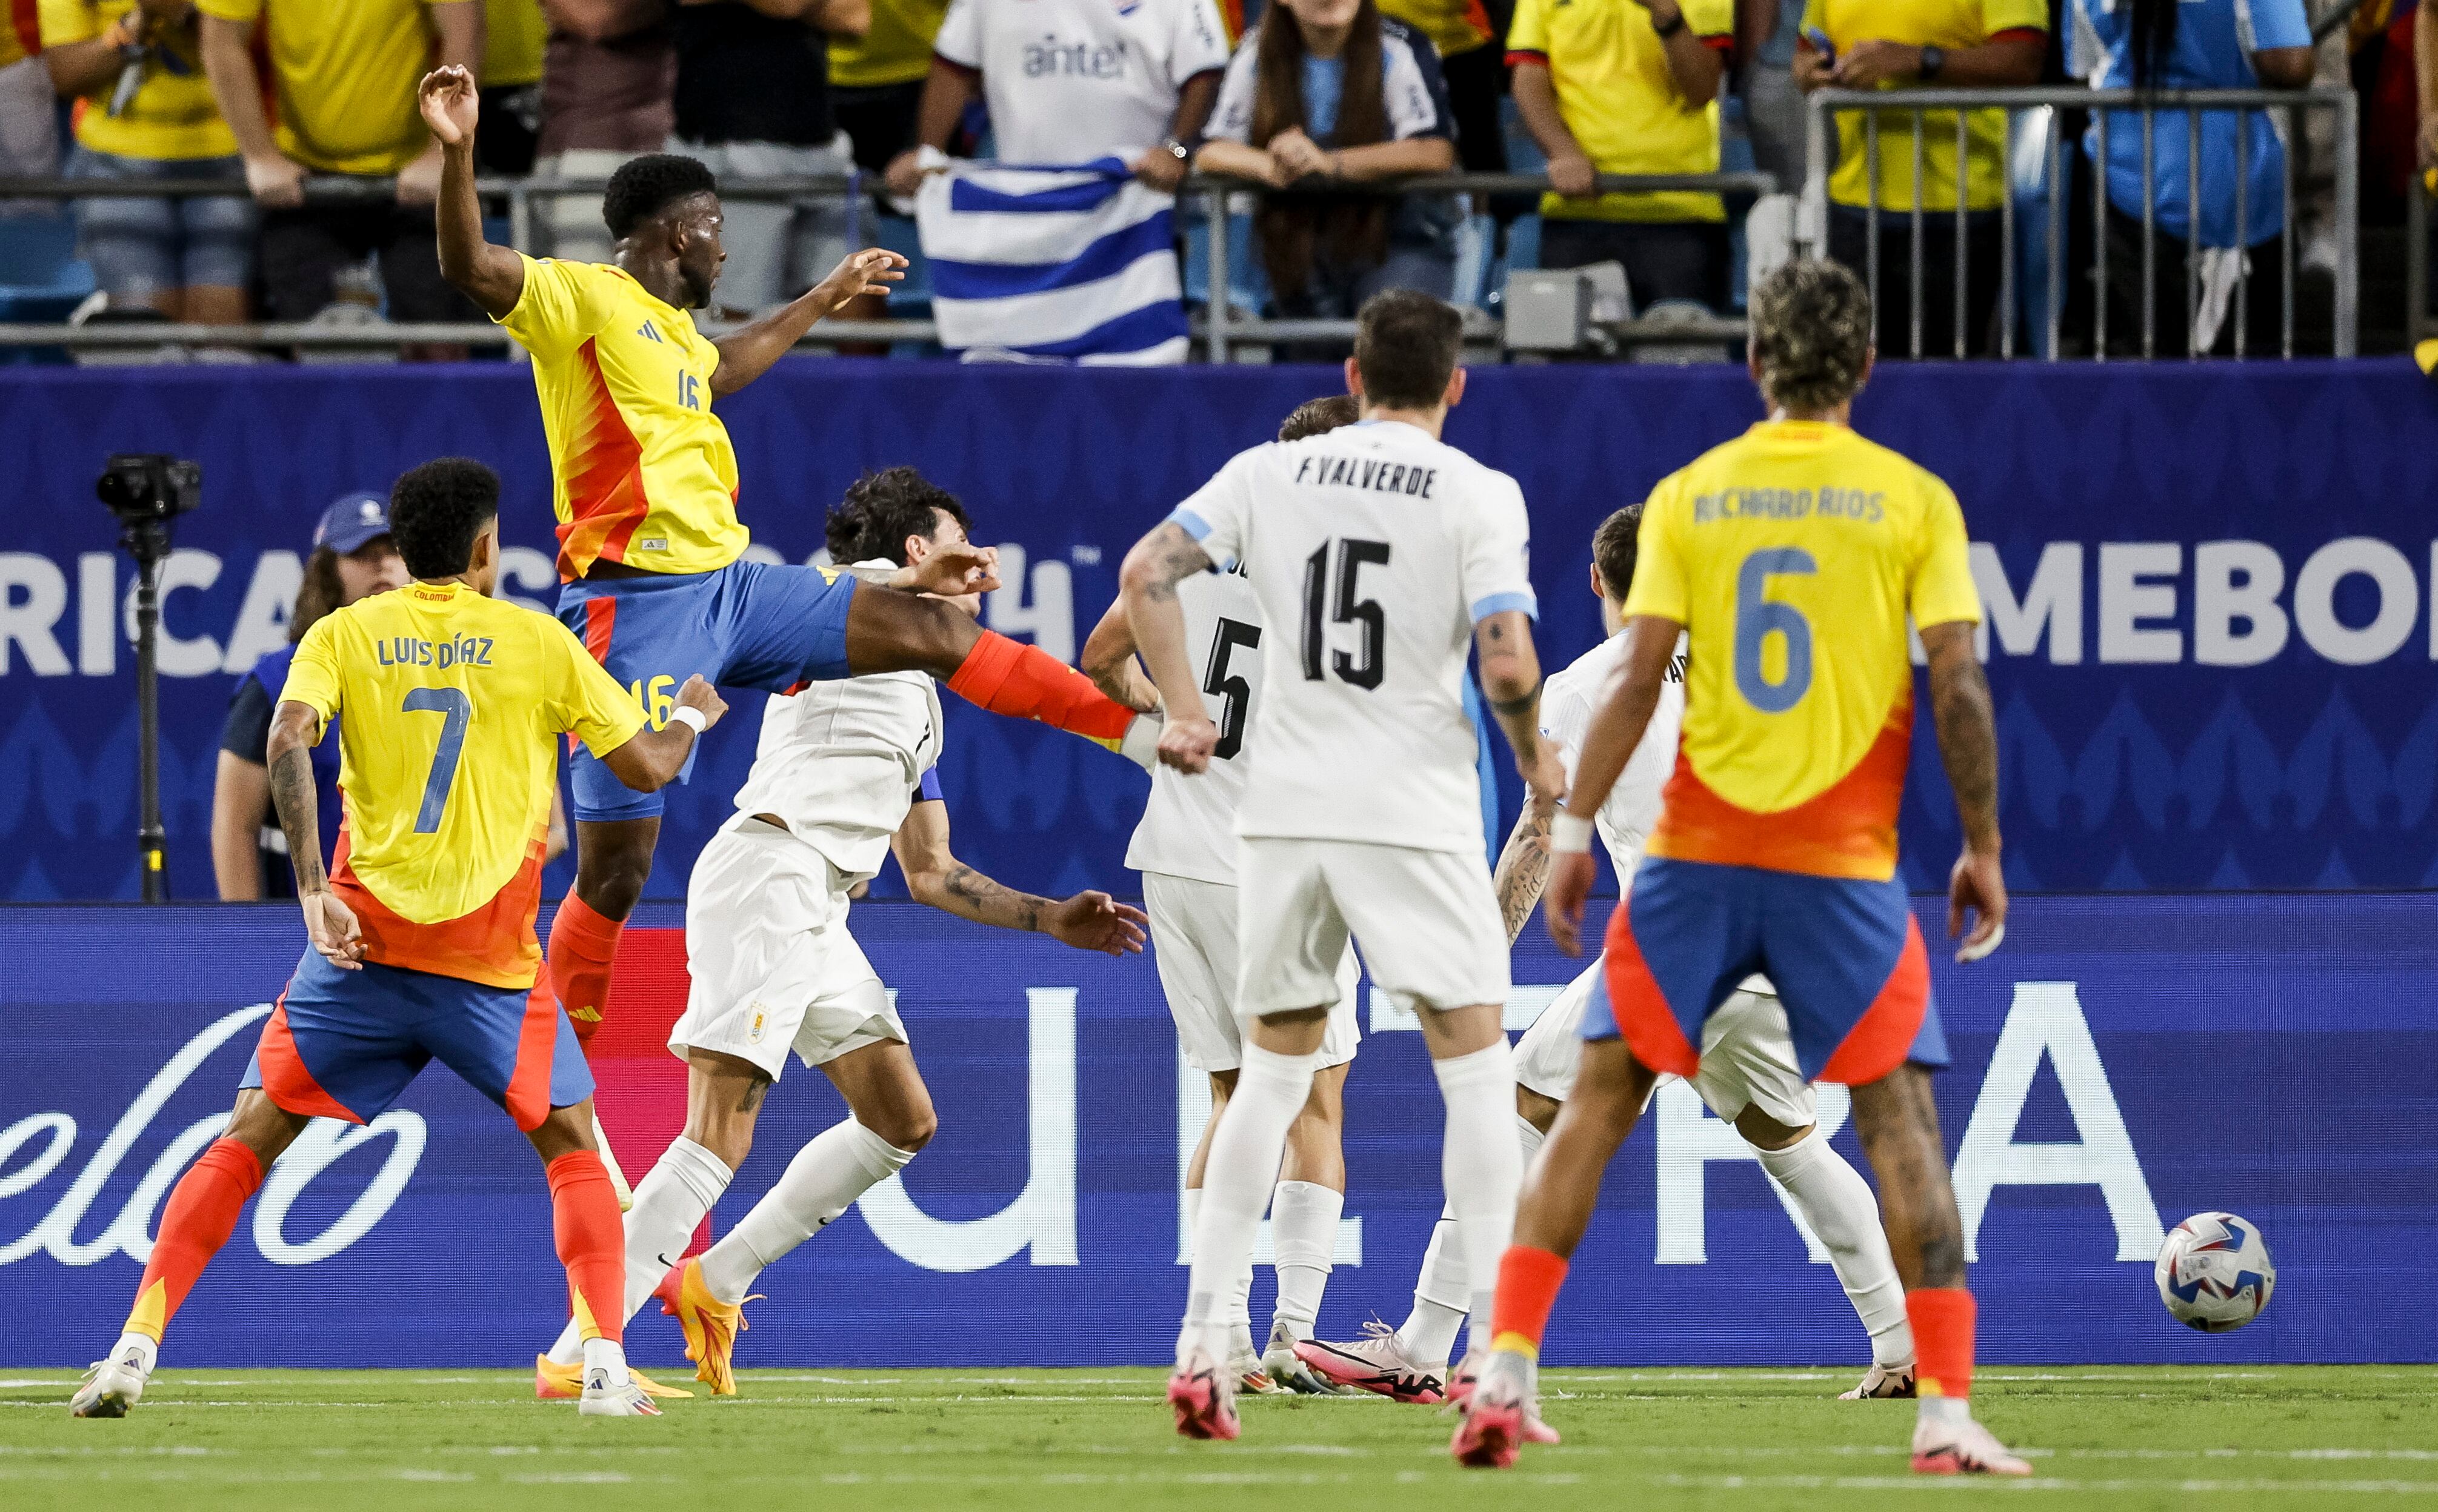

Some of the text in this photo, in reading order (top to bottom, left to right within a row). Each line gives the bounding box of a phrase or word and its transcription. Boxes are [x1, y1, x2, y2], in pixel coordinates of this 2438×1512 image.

[678, 368, 699, 411] 16
[1694, 486, 1813, 525] RICHARD
[378, 631, 493, 669] LUIS DÍAZ
[1301, 537, 1391, 691] 15
[1734, 546, 1819, 714] 6
[1909, 536, 2438, 665] MEBO
[631, 674, 675, 732] 16
[1203, 616, 1262, 760] 5
[402, 687, 471, 833] 7
